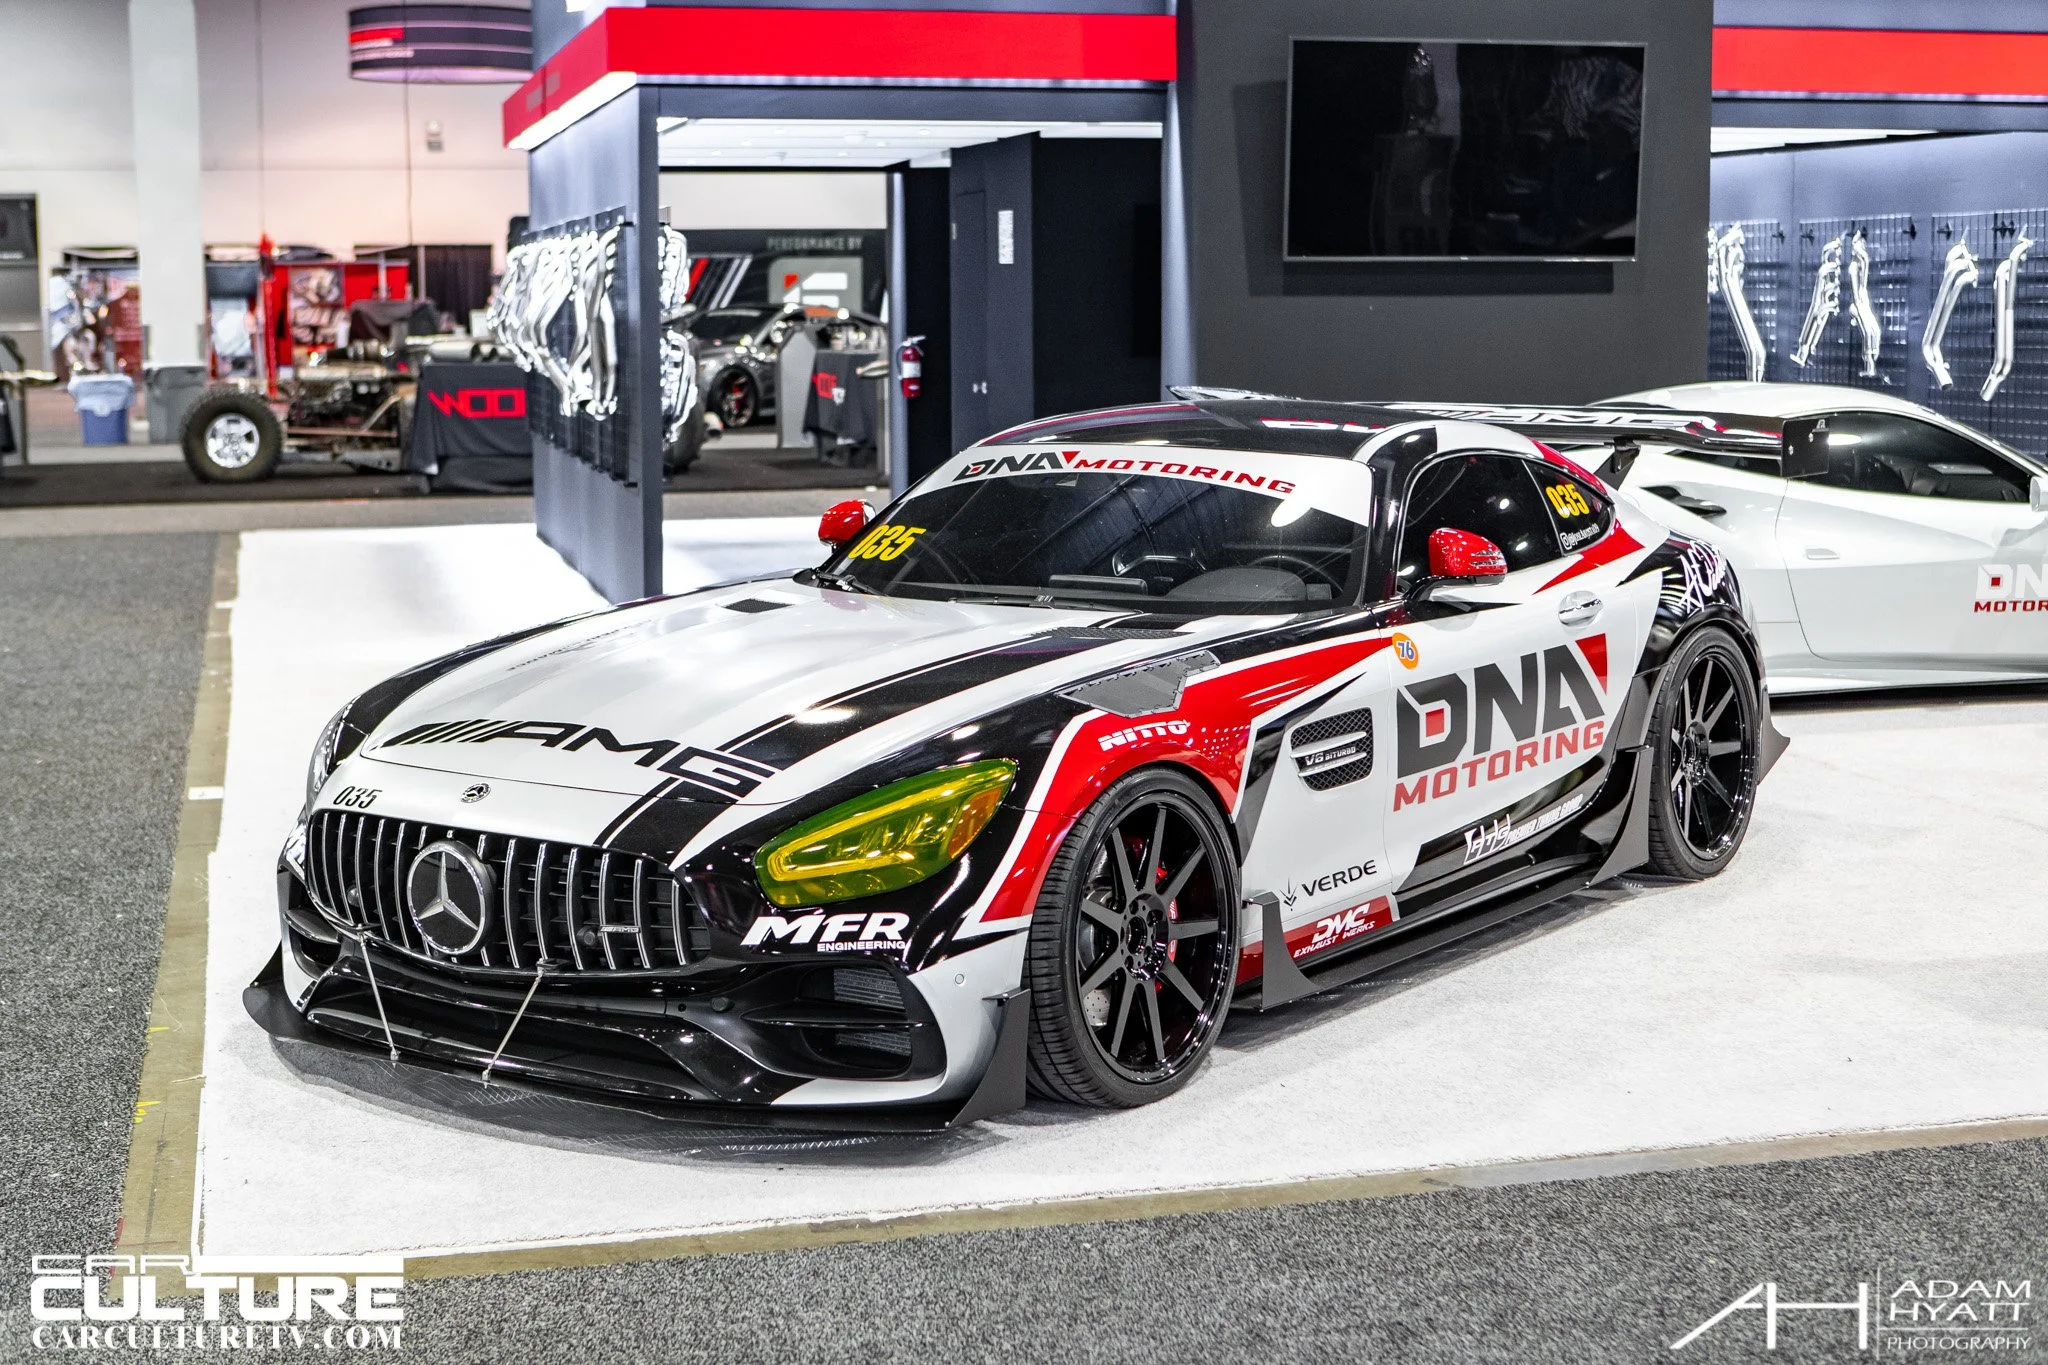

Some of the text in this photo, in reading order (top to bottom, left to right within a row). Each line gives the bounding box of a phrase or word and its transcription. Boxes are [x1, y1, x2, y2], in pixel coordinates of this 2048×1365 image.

[952, 450, 1296, 494] DNA MOTORING
[1545, 483, 1590, 518] 035
[847, 524, 927, 562] 035
[1397, 641, 1415, 661] 76
[1396, 636, 1607, 779] DNA
[1098, 719, 1191, 752] NITTO
[470, 720, 776, 798] AMG
[1393, 720, 1605, 812] MOTORING
[333, 786, 383, 809] 035
[1301, 859, 1377, 897] VERDE
[740, 912, 911, 946] MFR
[1293, 921, 1376, 958] EXHAUST WERKS
[1311, 903, 1371, 944] DMC
[817, 940, 907, 953] ENGINEERING
